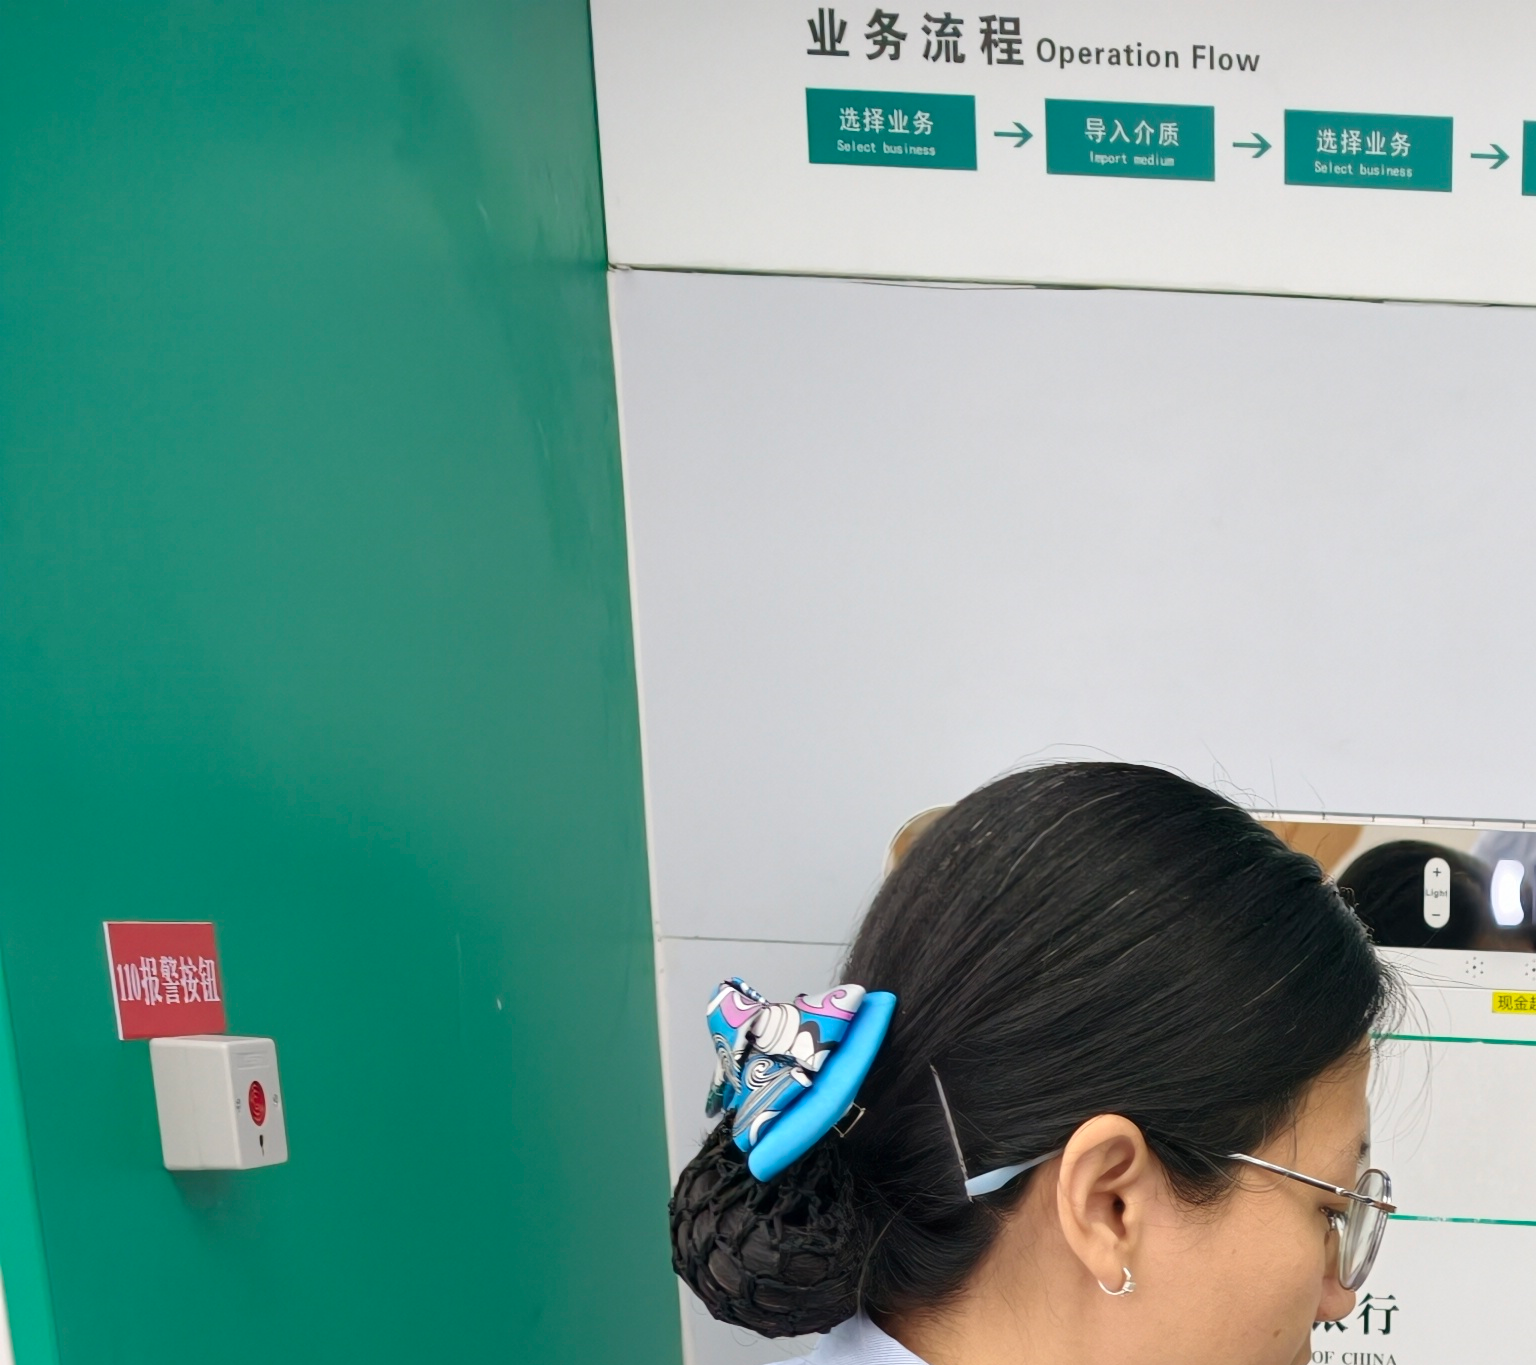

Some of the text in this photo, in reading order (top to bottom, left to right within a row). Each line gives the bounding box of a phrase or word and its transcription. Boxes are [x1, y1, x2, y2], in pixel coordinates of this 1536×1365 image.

[806, 7, 1260, 72] 业务流程 Operation Flow
[838, 107, 934, 136] 选择业务
[1084, 117, 1180, 148] 导入介质
[836, 139, 936, 157] Select business
[1316, 129, 1412, 158] 选择业务
[1089, 151, 1175, 167] Import medium
[1314, 162, 1413, 179] Select business
[1425, 889, 1448, 899] Light
[116, 955, 222, 1006] 110报警按钮
[1312, 1350, 1335, 1365] OF
